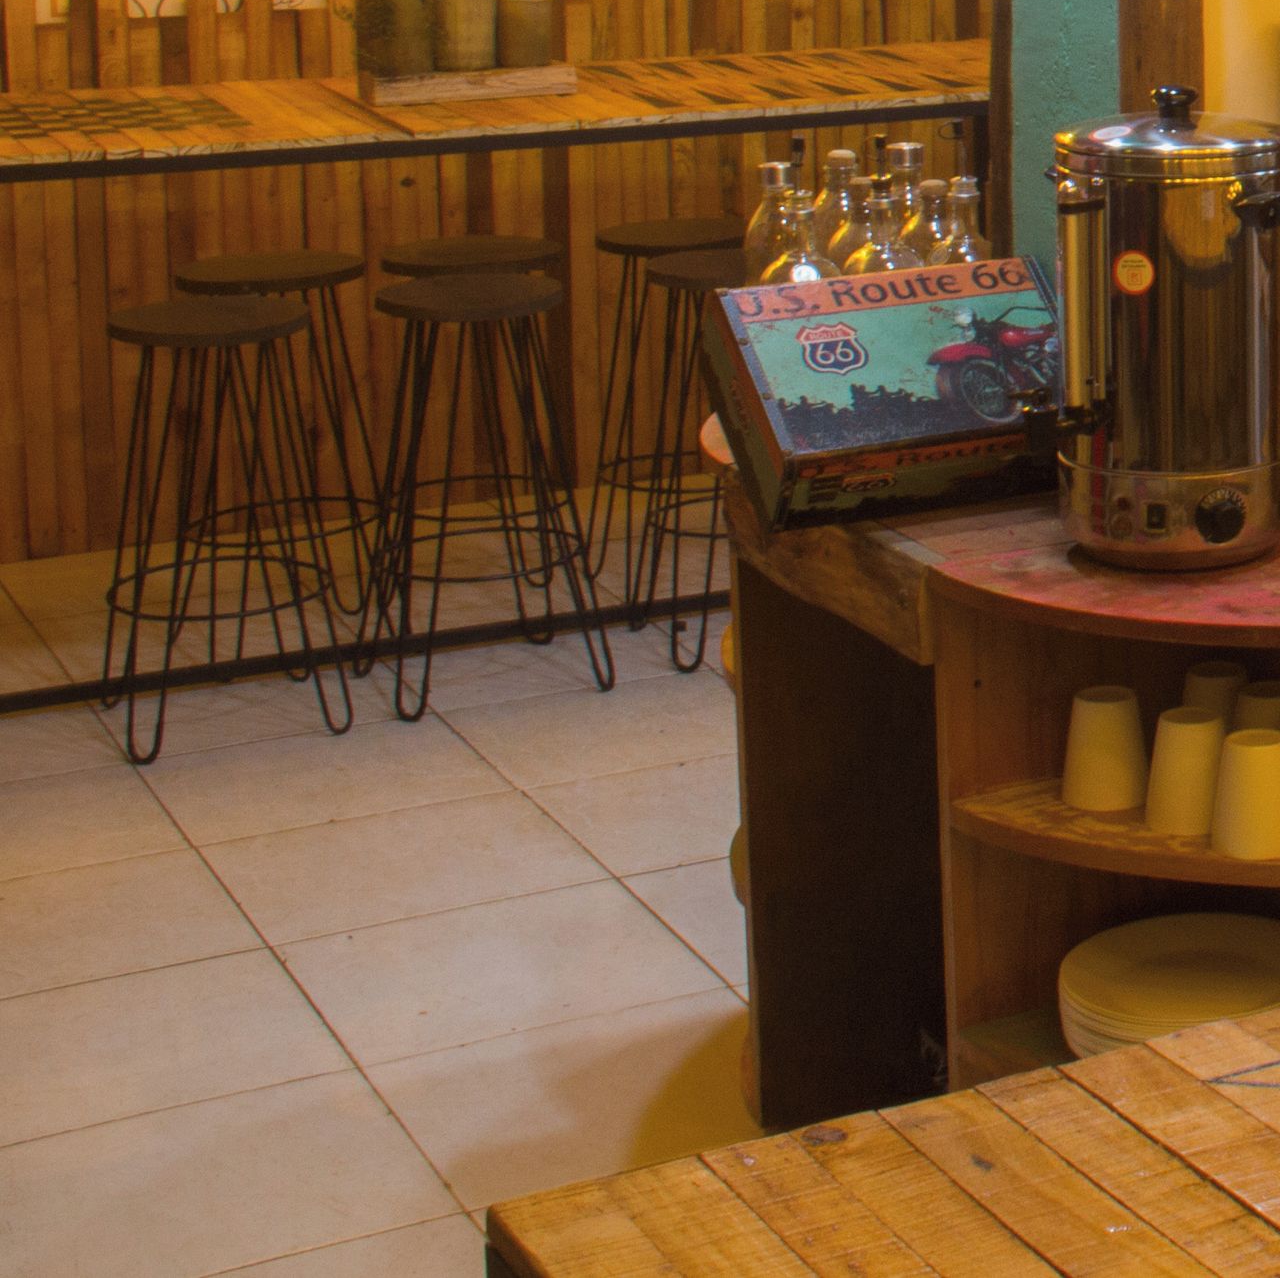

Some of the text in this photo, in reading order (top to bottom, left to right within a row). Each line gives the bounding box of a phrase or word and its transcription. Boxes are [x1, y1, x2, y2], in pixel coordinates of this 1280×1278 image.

[735, 263, 1026, 318] U.S. Route 66
[816, 342, 855, 364] 66
